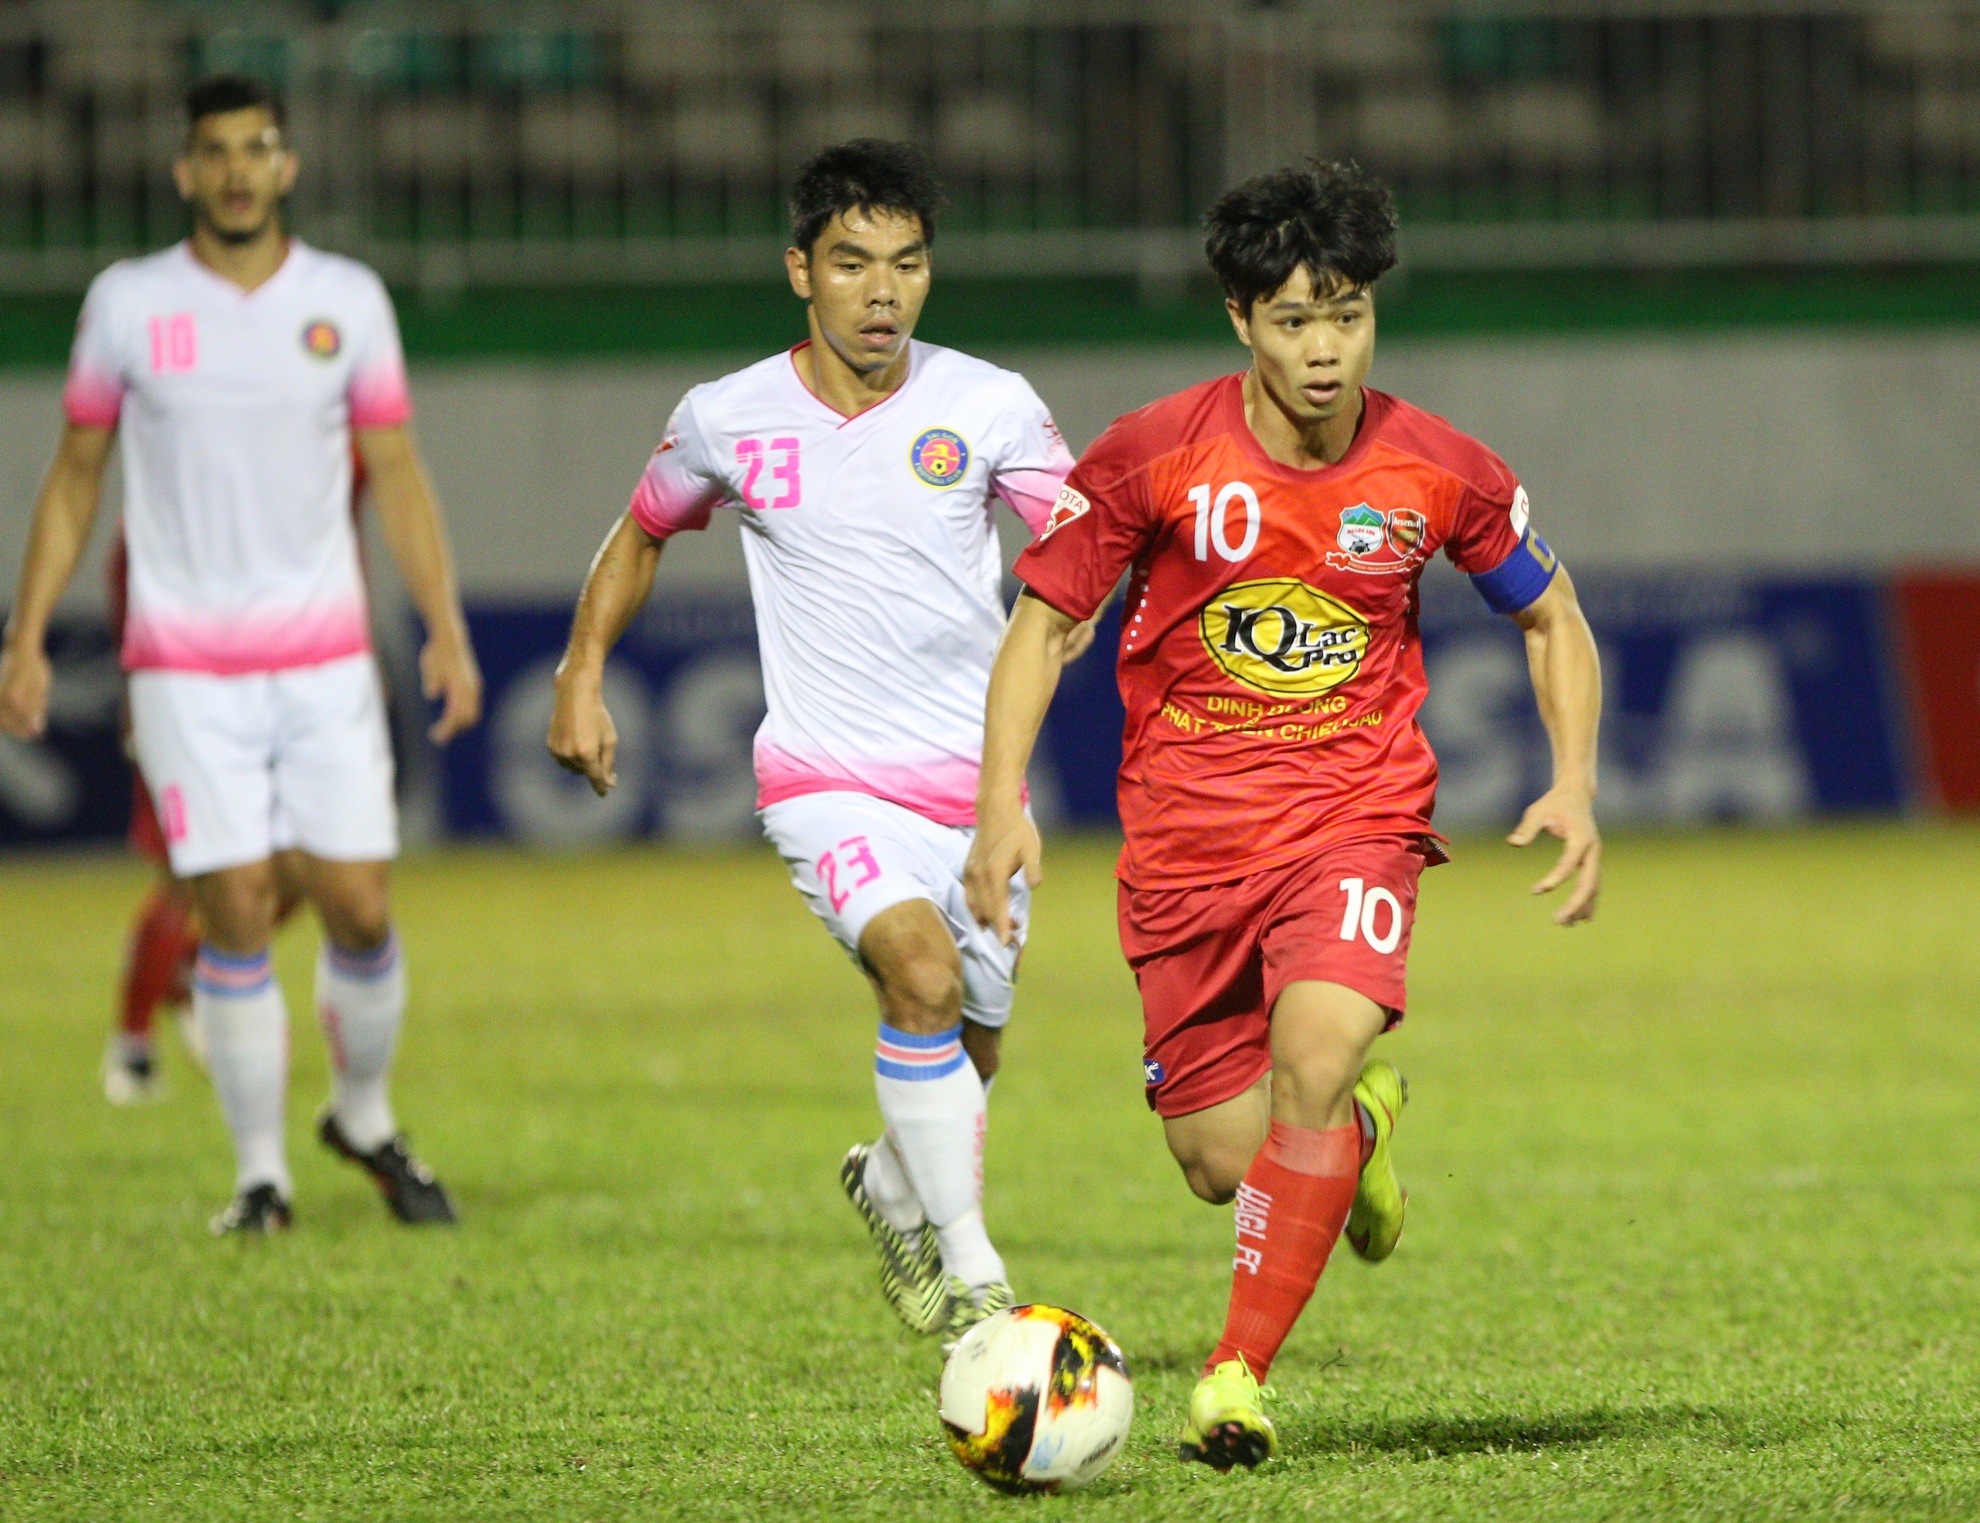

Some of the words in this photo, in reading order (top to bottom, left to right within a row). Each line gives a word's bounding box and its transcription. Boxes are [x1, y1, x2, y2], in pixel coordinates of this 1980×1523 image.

[147, 313, 199, 376] 10
[735, 437, 801, 510] 23
[1187, 480, 1262, 563] 10
[1218, 603, 1305, 673] IQ
[1299, 622, 1358, 648] Lac
[1302, 648, 1358, 669] Pro
[815, 835, 882, 916] 23
[1339, 877, 1403, 955] 10
[1234, 1181, 1273, 1241] HAGL
[1232, 1243, 1263, 1276] FC
